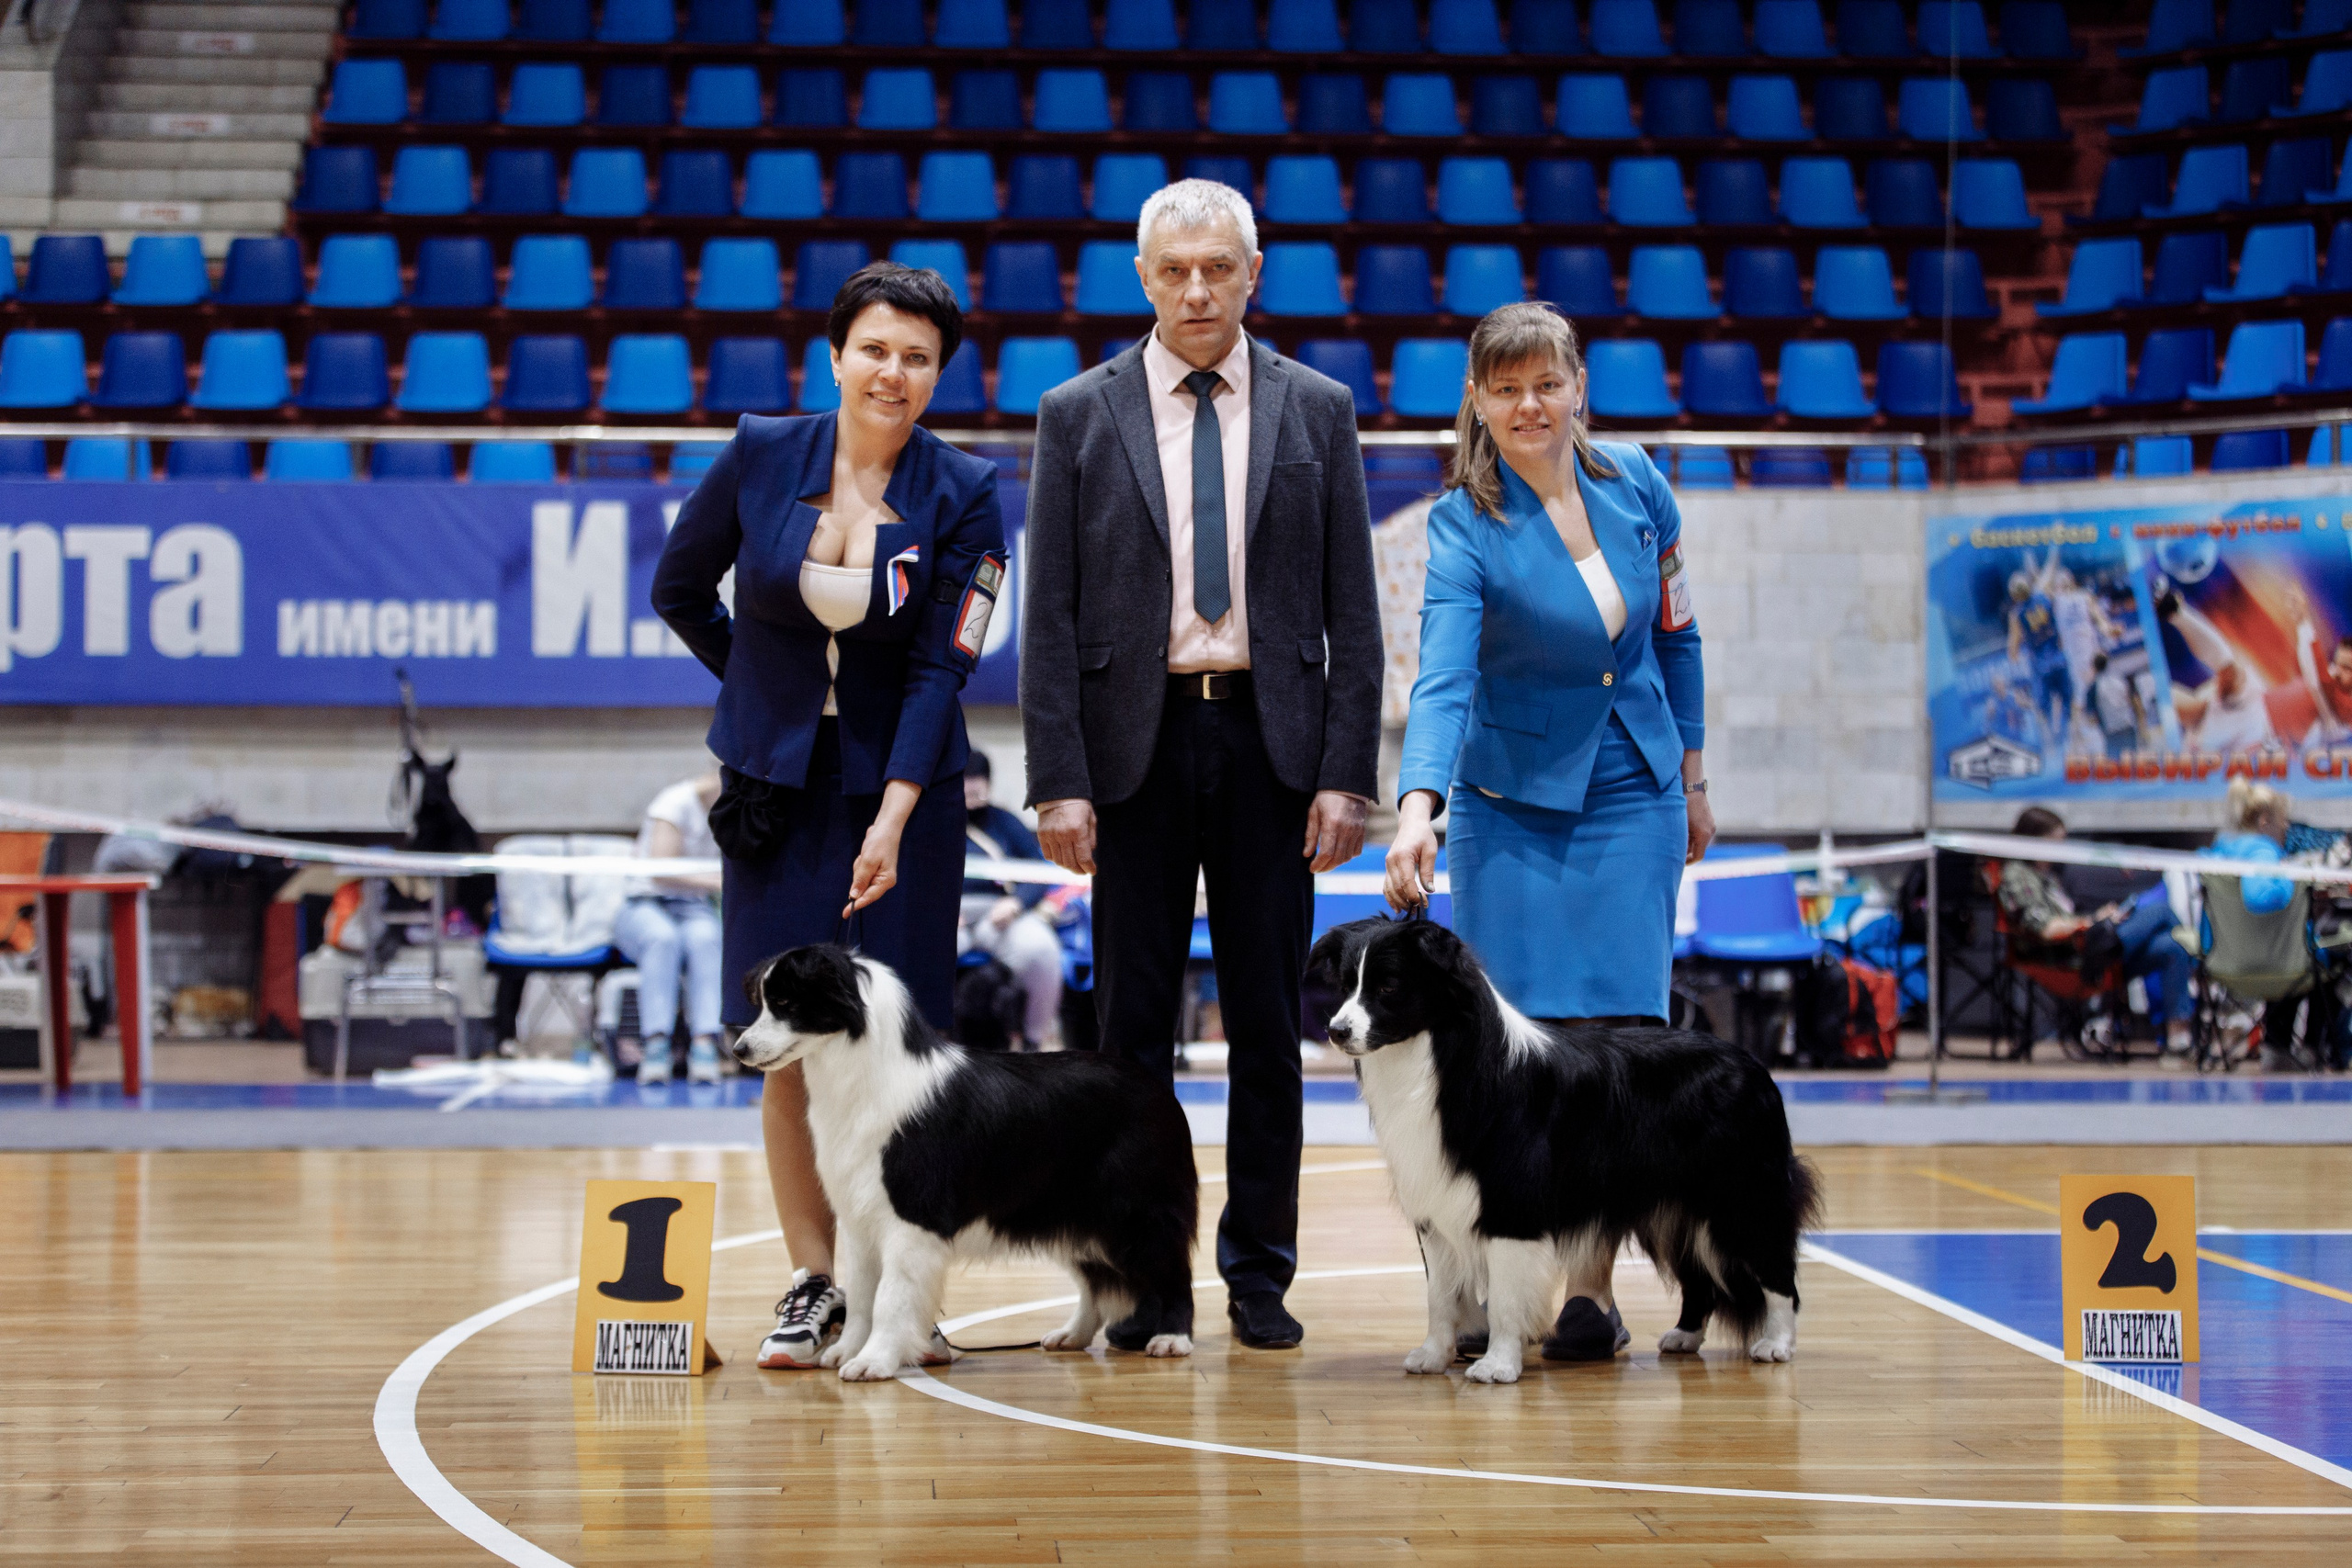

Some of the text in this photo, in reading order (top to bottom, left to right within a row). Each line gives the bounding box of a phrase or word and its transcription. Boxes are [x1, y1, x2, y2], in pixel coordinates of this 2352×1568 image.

[0, 522, 243, 673] рта
[277, 599, 496, 659] имени
[2064, 746, 2288, 783] ВЫБИРАЙ
[597, 1197, 684, 1303] 1
[2083, 1191, 2177, 1294] 2
[596, 1323, 688, 1371] МАГНИТКА
[2084, 1313, 2179, 1359] МАГНИТКА
